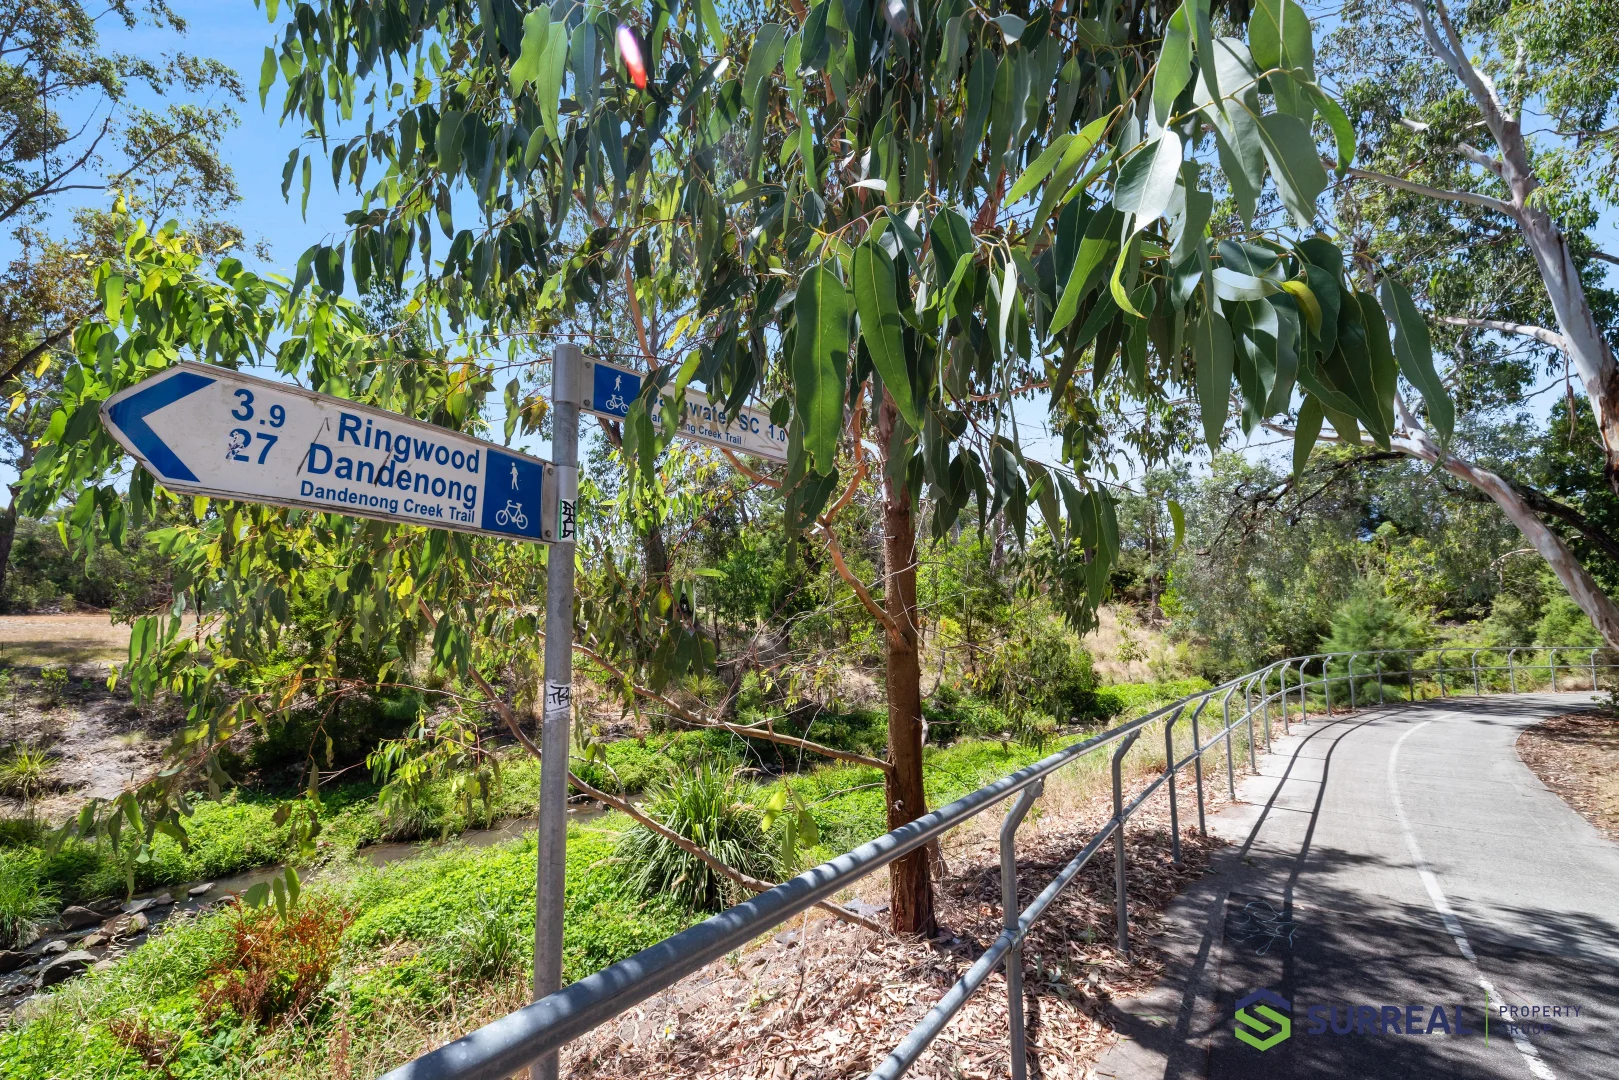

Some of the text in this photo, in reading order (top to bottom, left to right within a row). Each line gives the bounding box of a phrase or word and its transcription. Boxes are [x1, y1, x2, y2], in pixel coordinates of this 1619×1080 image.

[231, 388, 480, 474] 3.9 Ringwood
[699, 426, 742, 445] Creek Trail
[739, 414, 760, 434] SC
[769, 423, 785, 442] 1.0
[226, 428, 478, 510] 27 Dandenong
[300, 480, 475, 523] Dandenong Creek Trail
